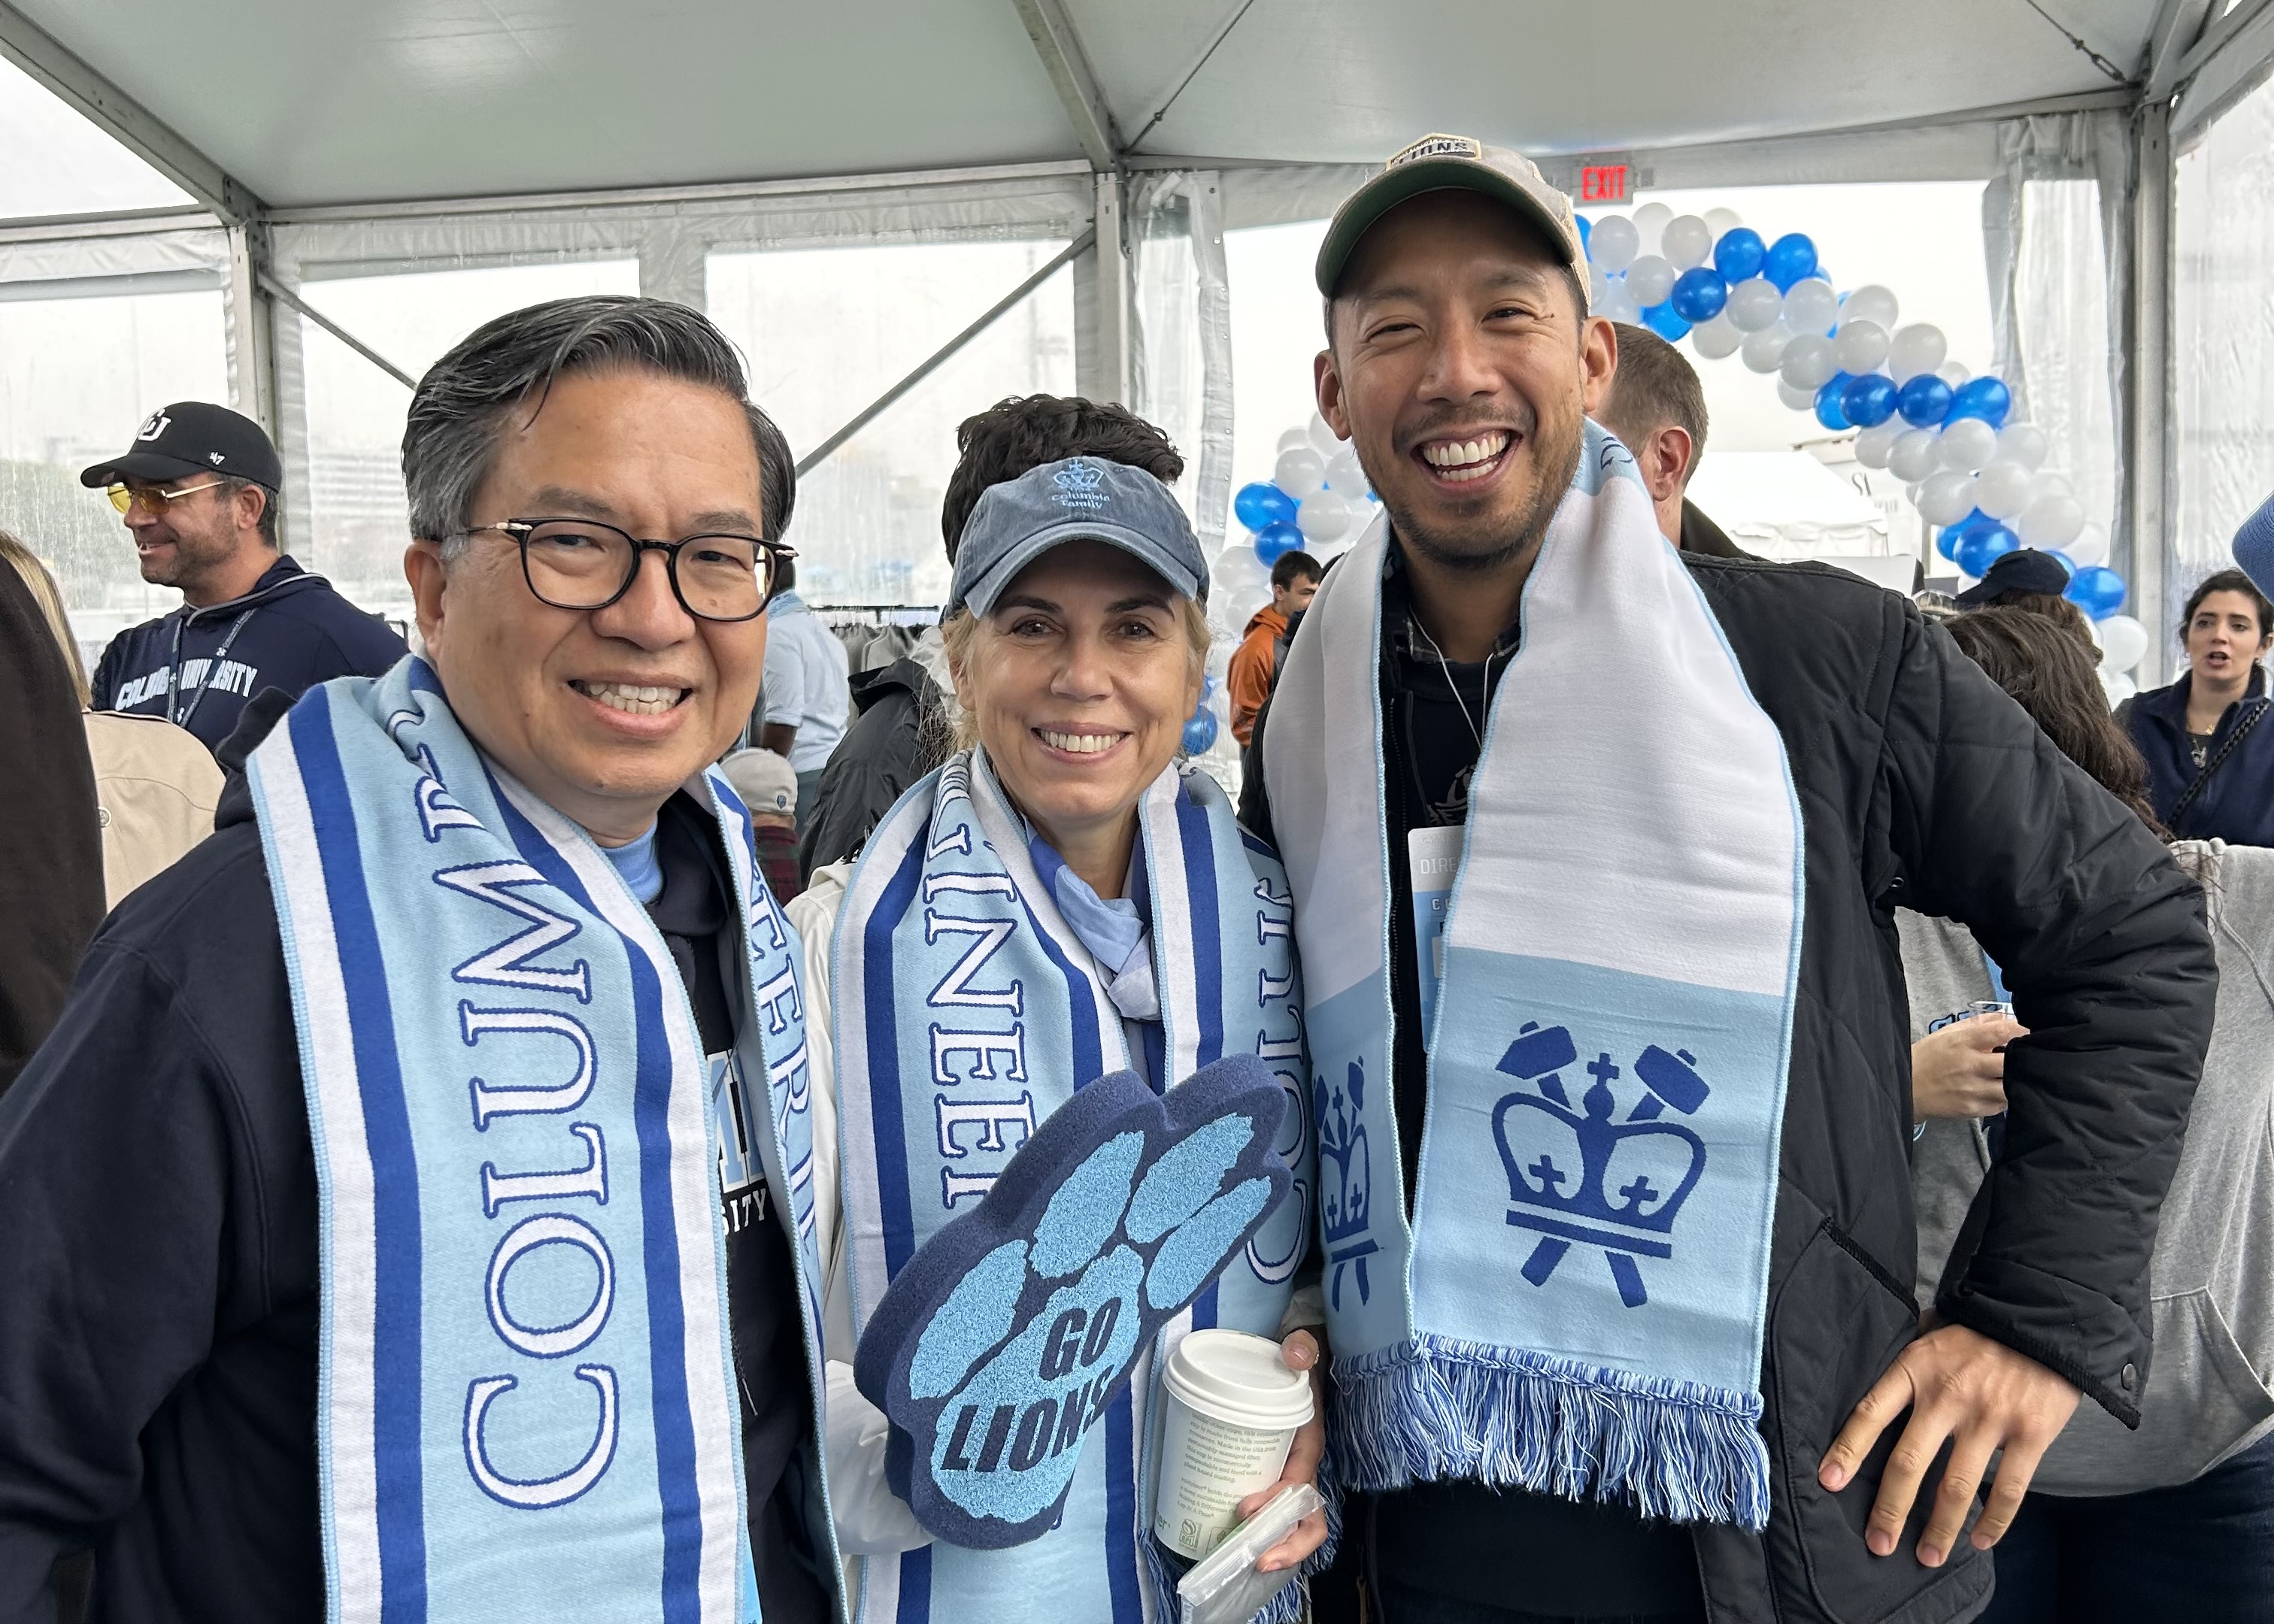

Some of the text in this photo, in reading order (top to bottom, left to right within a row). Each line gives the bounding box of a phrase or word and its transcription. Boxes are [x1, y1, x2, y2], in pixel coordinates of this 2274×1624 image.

[1582, 165, 1628, 201] EXIT
[115, 665, 183, 711] COLUMB
[181, 659, 258, 698] UNIVRSITY
[1420, 856, 1459, 874] DIRE
[1039, 1297, 1122, 1381] GO
[941, 1364, 1114, 1473] LIONS
